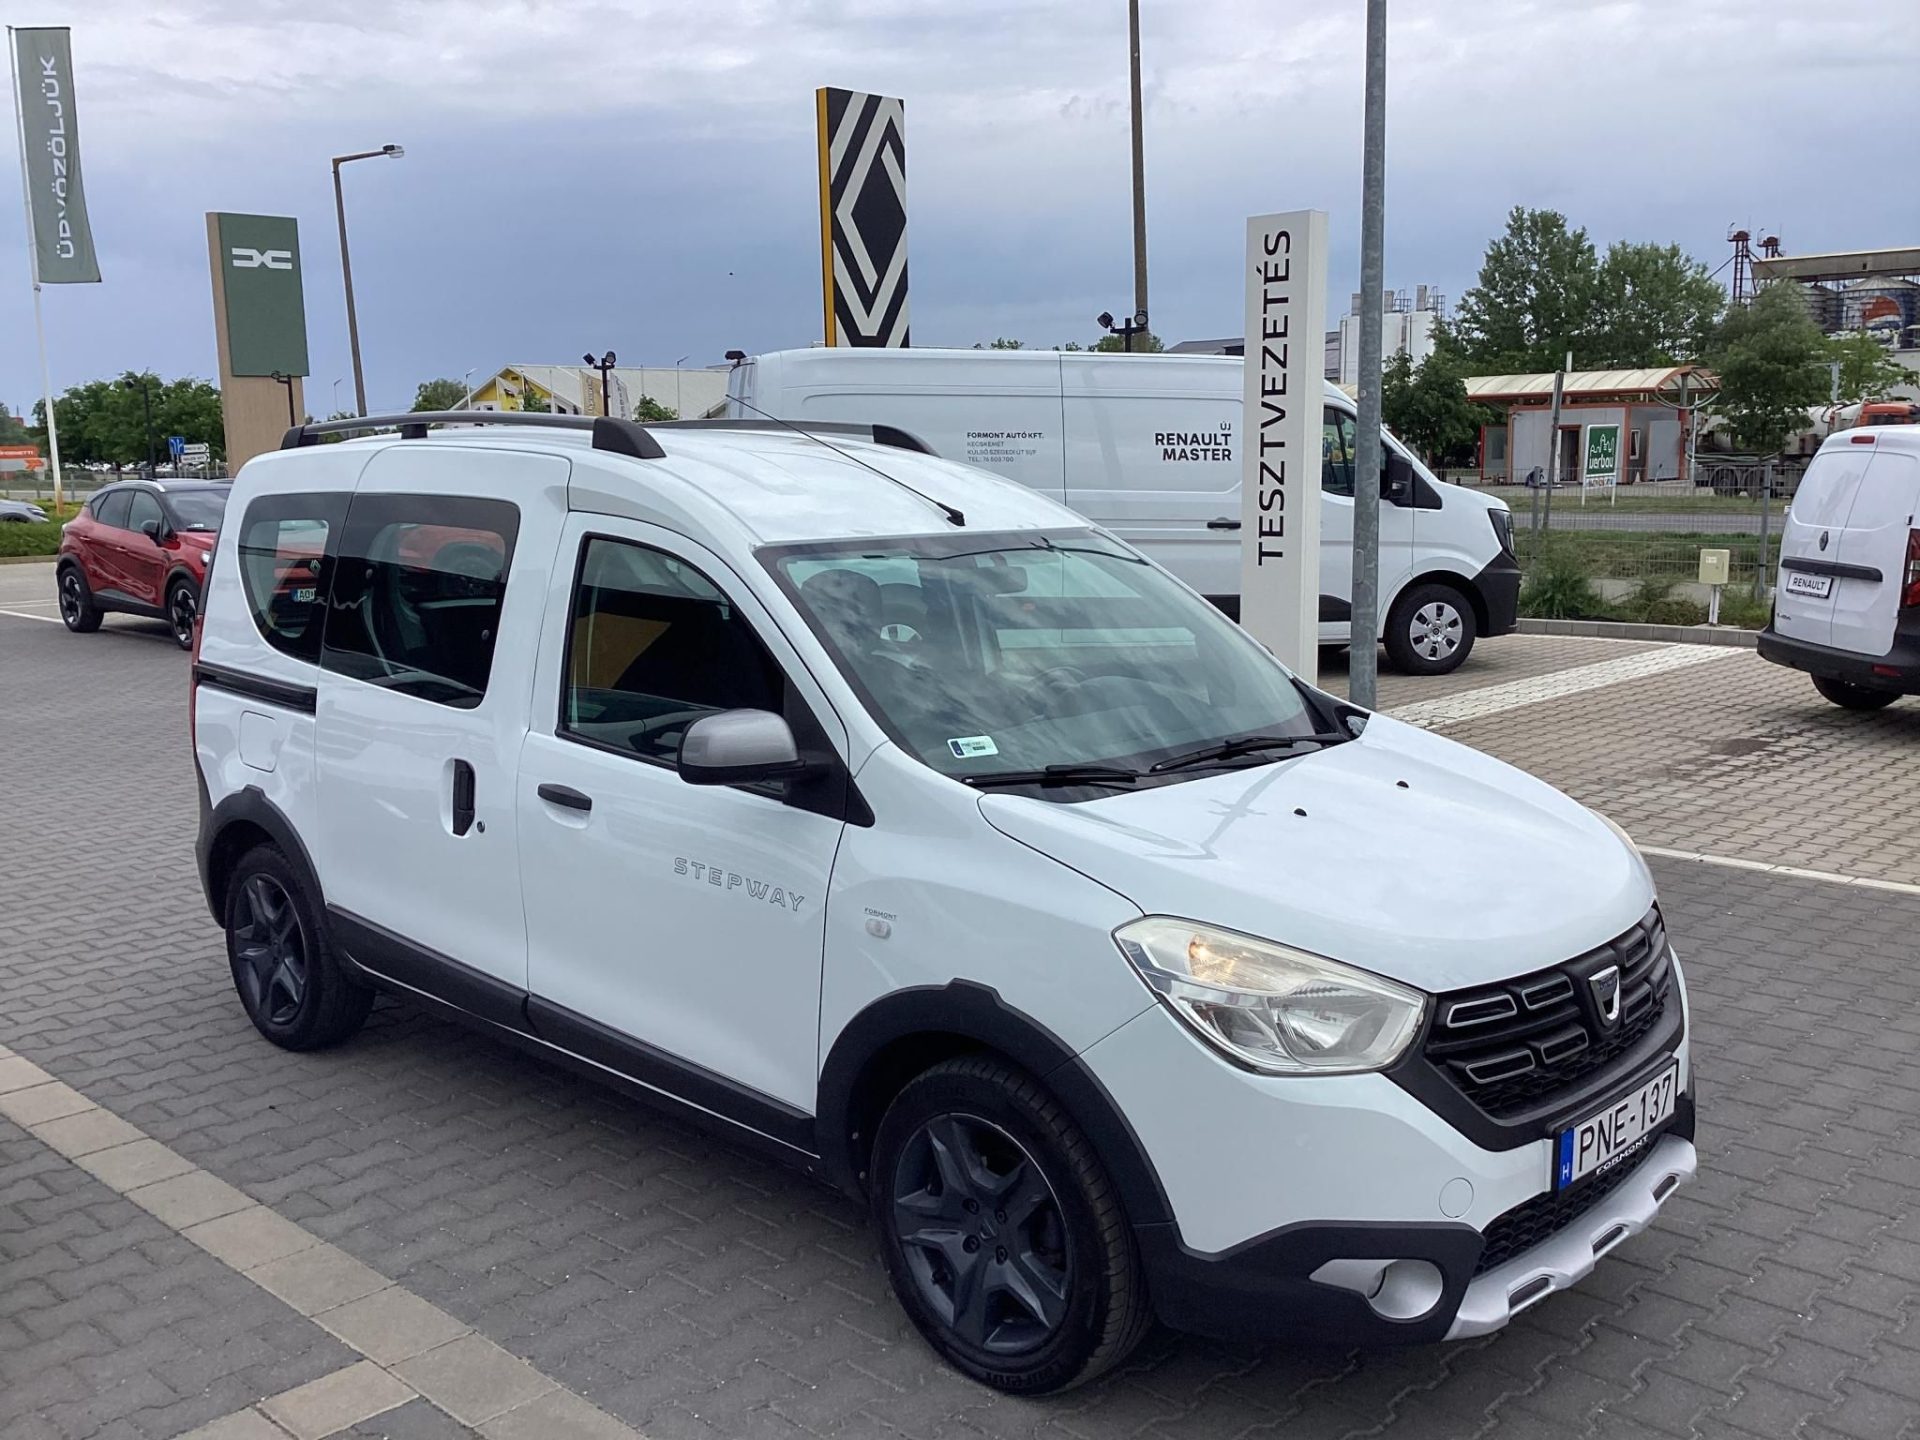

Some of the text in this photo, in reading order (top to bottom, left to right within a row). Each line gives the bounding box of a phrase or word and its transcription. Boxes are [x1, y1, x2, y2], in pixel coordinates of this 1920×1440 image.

[1256, 230, 1291, 566] TESZTVEZETÉS
[967, 431, 1044, 440] FORMONT AUTÓ KFT.
[1155, 432, 1232, 446] RENAULT
[1162, 448, 1232, 461] MASTER
[1793, 577, 1826, 591] RENAULT
[674, 857, 805, 912] STEPWAY
[1562, 1073, 1672, 1180] H PNE-137
[1596, 1134, 1649, 1175] FORMONT
